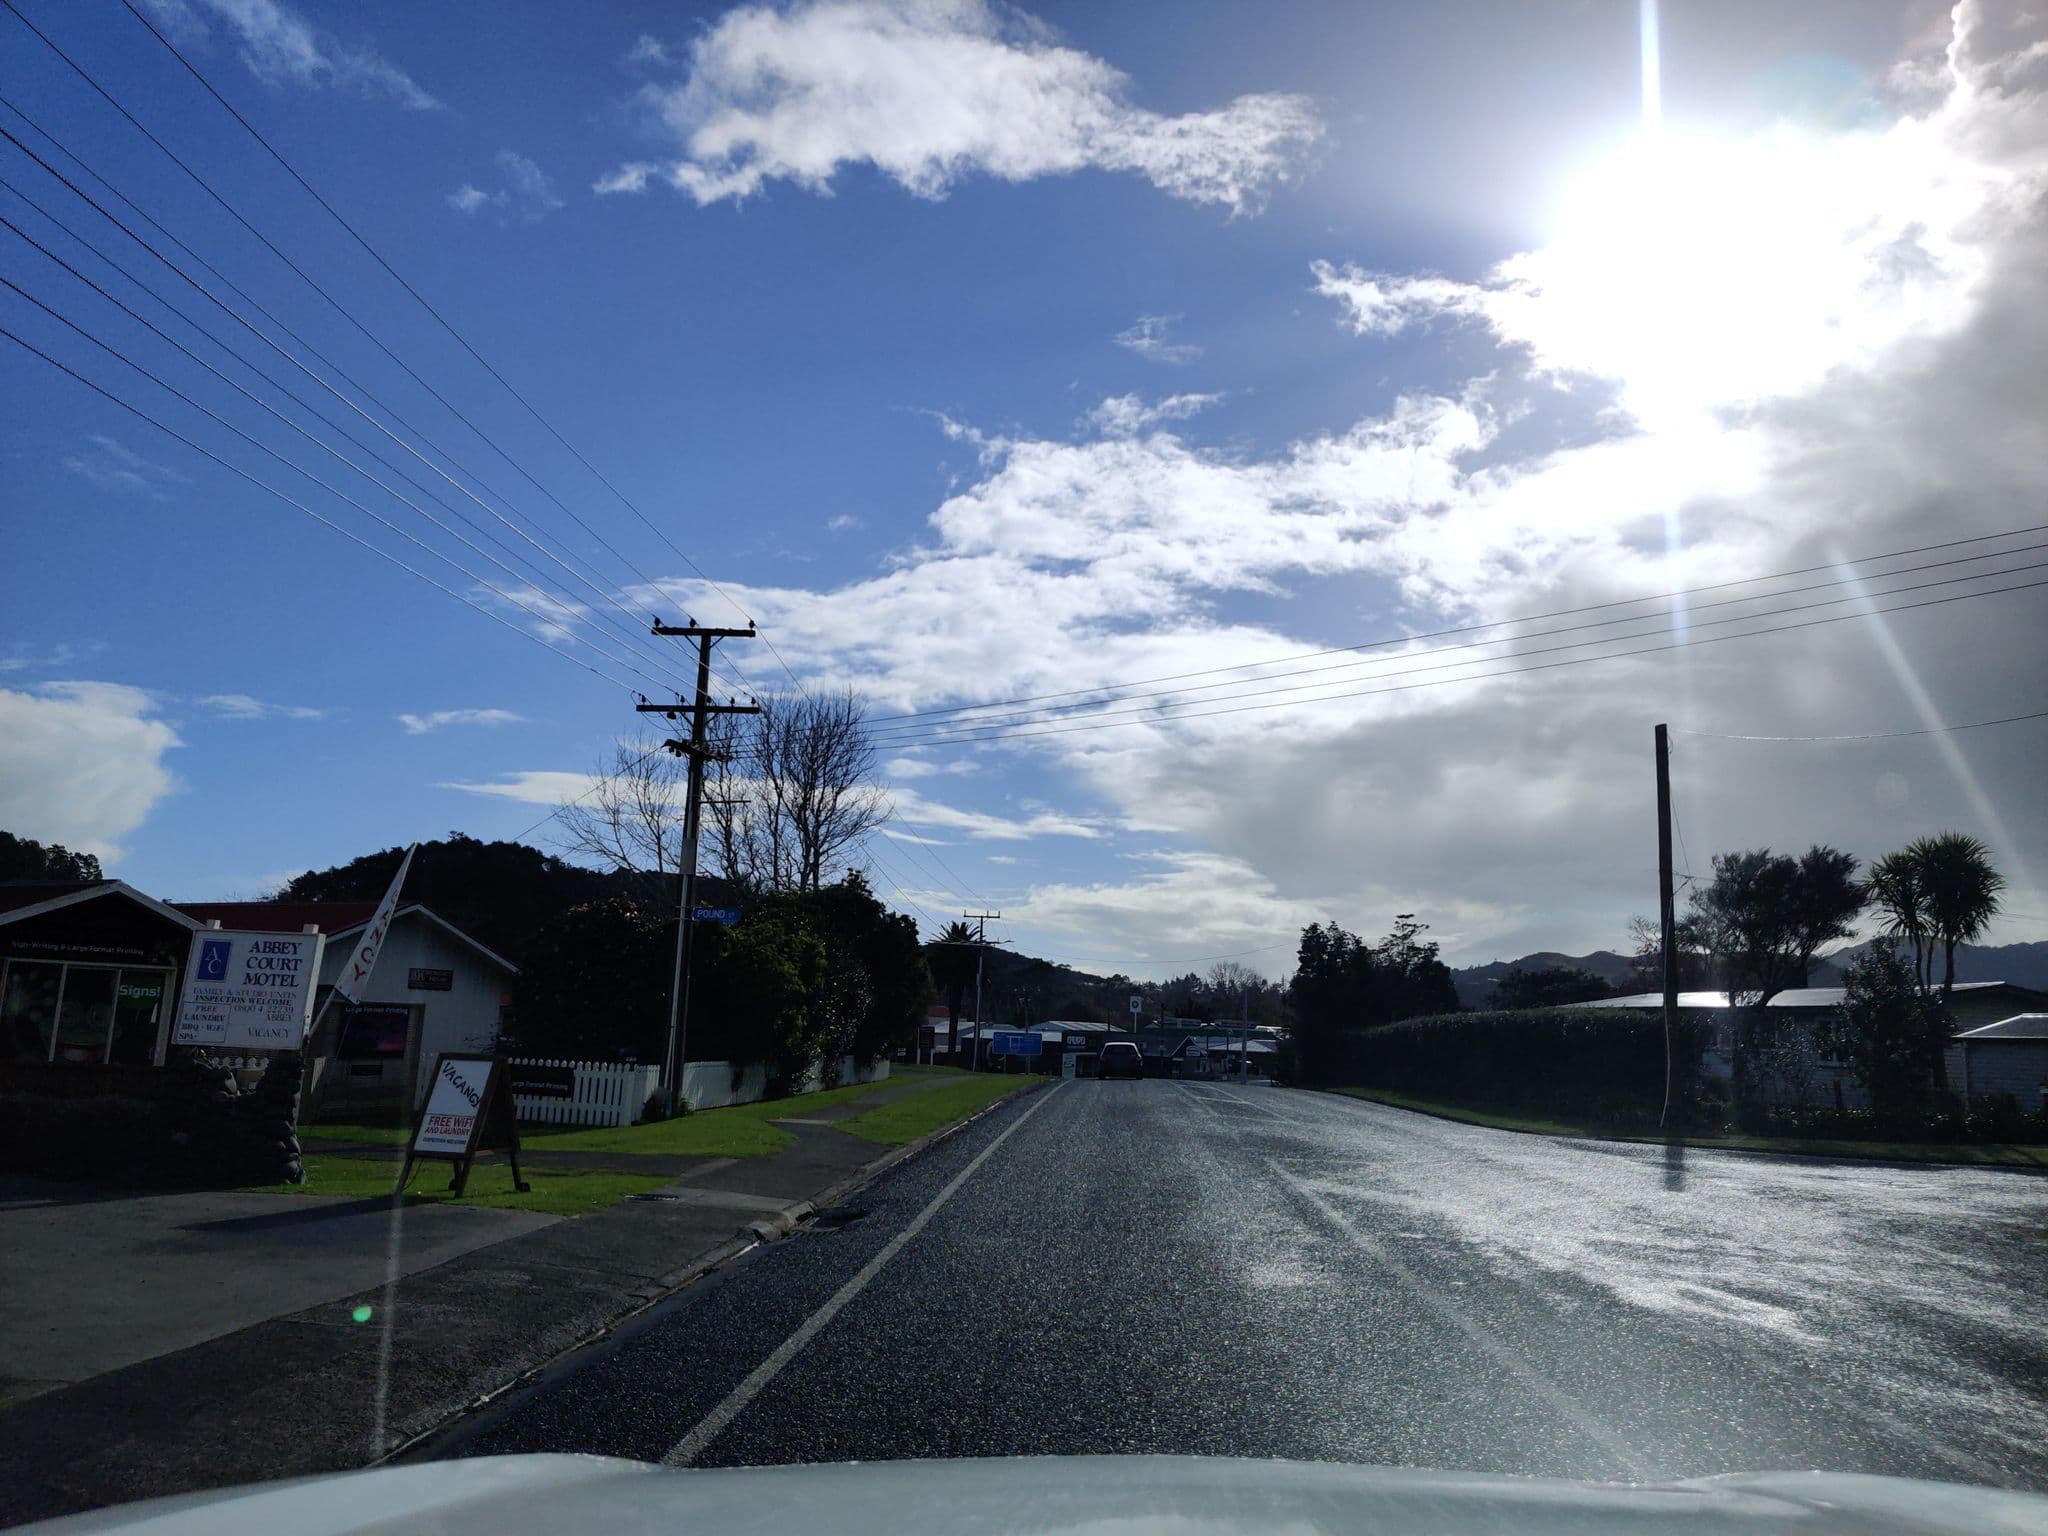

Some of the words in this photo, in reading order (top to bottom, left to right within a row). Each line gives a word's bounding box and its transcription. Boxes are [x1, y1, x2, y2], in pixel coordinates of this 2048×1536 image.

[697, 909, 725, 919] POUND
[88, 945, 114, 953] Format
[249, 940, 303, 955] ABBEY
[246, 956, 304, 972] COURT
[243, 972, 299, 988] MOTEL
[119, 984, 161, 999] Signs!
[193, 987, 222, 996] FAMILY
[195, 994, 245, 1004] INSPECTION
[248, 997, 292, 1006] WELCOME
[195, 1005, 217, 1013] FREE
[183, 1013, 226, 1022] LAUNDRY
[181, 1023, 199, 1031] BBQ
[247, 1026, 289, 1038] VACANCY
[429, 1116, 452, 1127] FREE
[425, 1127, 439, 1135] AND
[440, 1127, 470, 1137] LAUNDRY
